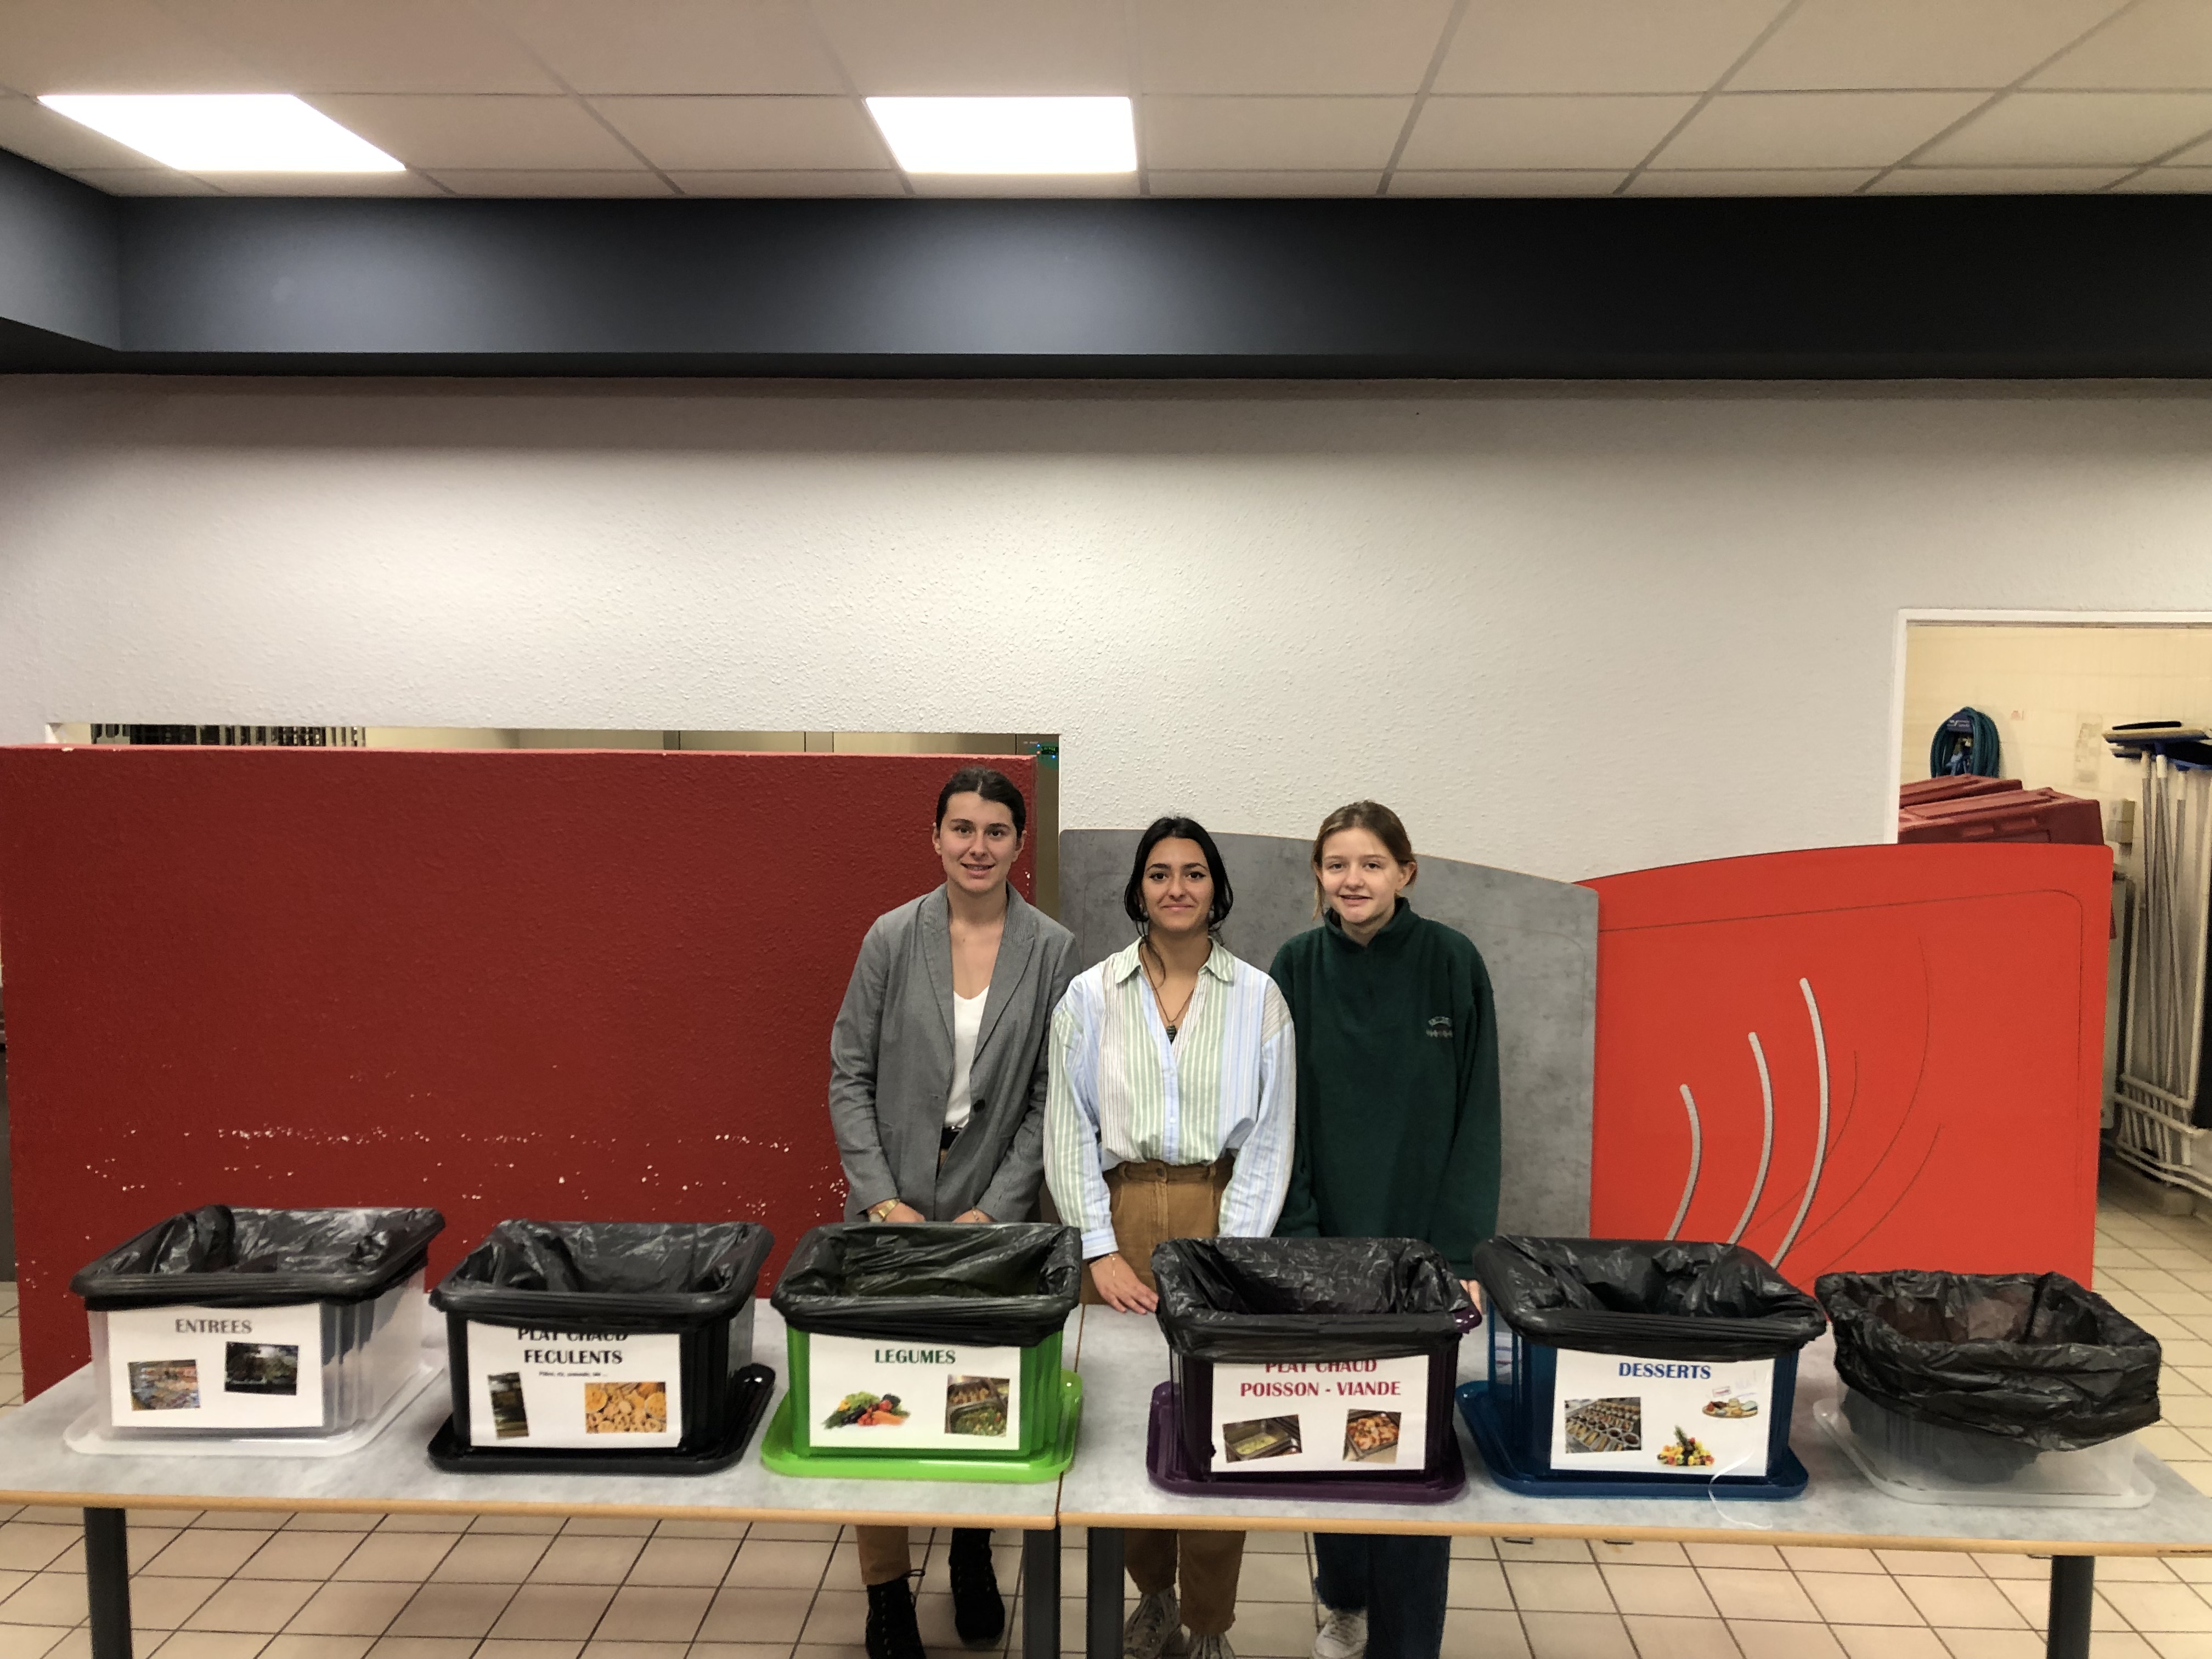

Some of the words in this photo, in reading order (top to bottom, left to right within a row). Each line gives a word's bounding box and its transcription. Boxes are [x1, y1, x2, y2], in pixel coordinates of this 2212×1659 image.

[174, 1318, 253, 1334] ENTREES
[524, 1349, 623, 1364] FECULENTS
[874, 1348, 956, 1364] LEGUMES
[1314, 1360, 1378, 1373] CHAUD
[1618, 1362, 1712, 1380] DESSERTS
[1240, 1381, 1319, 1397] POISSON
[1336, 1380, 1402, 1396] VIANDE
